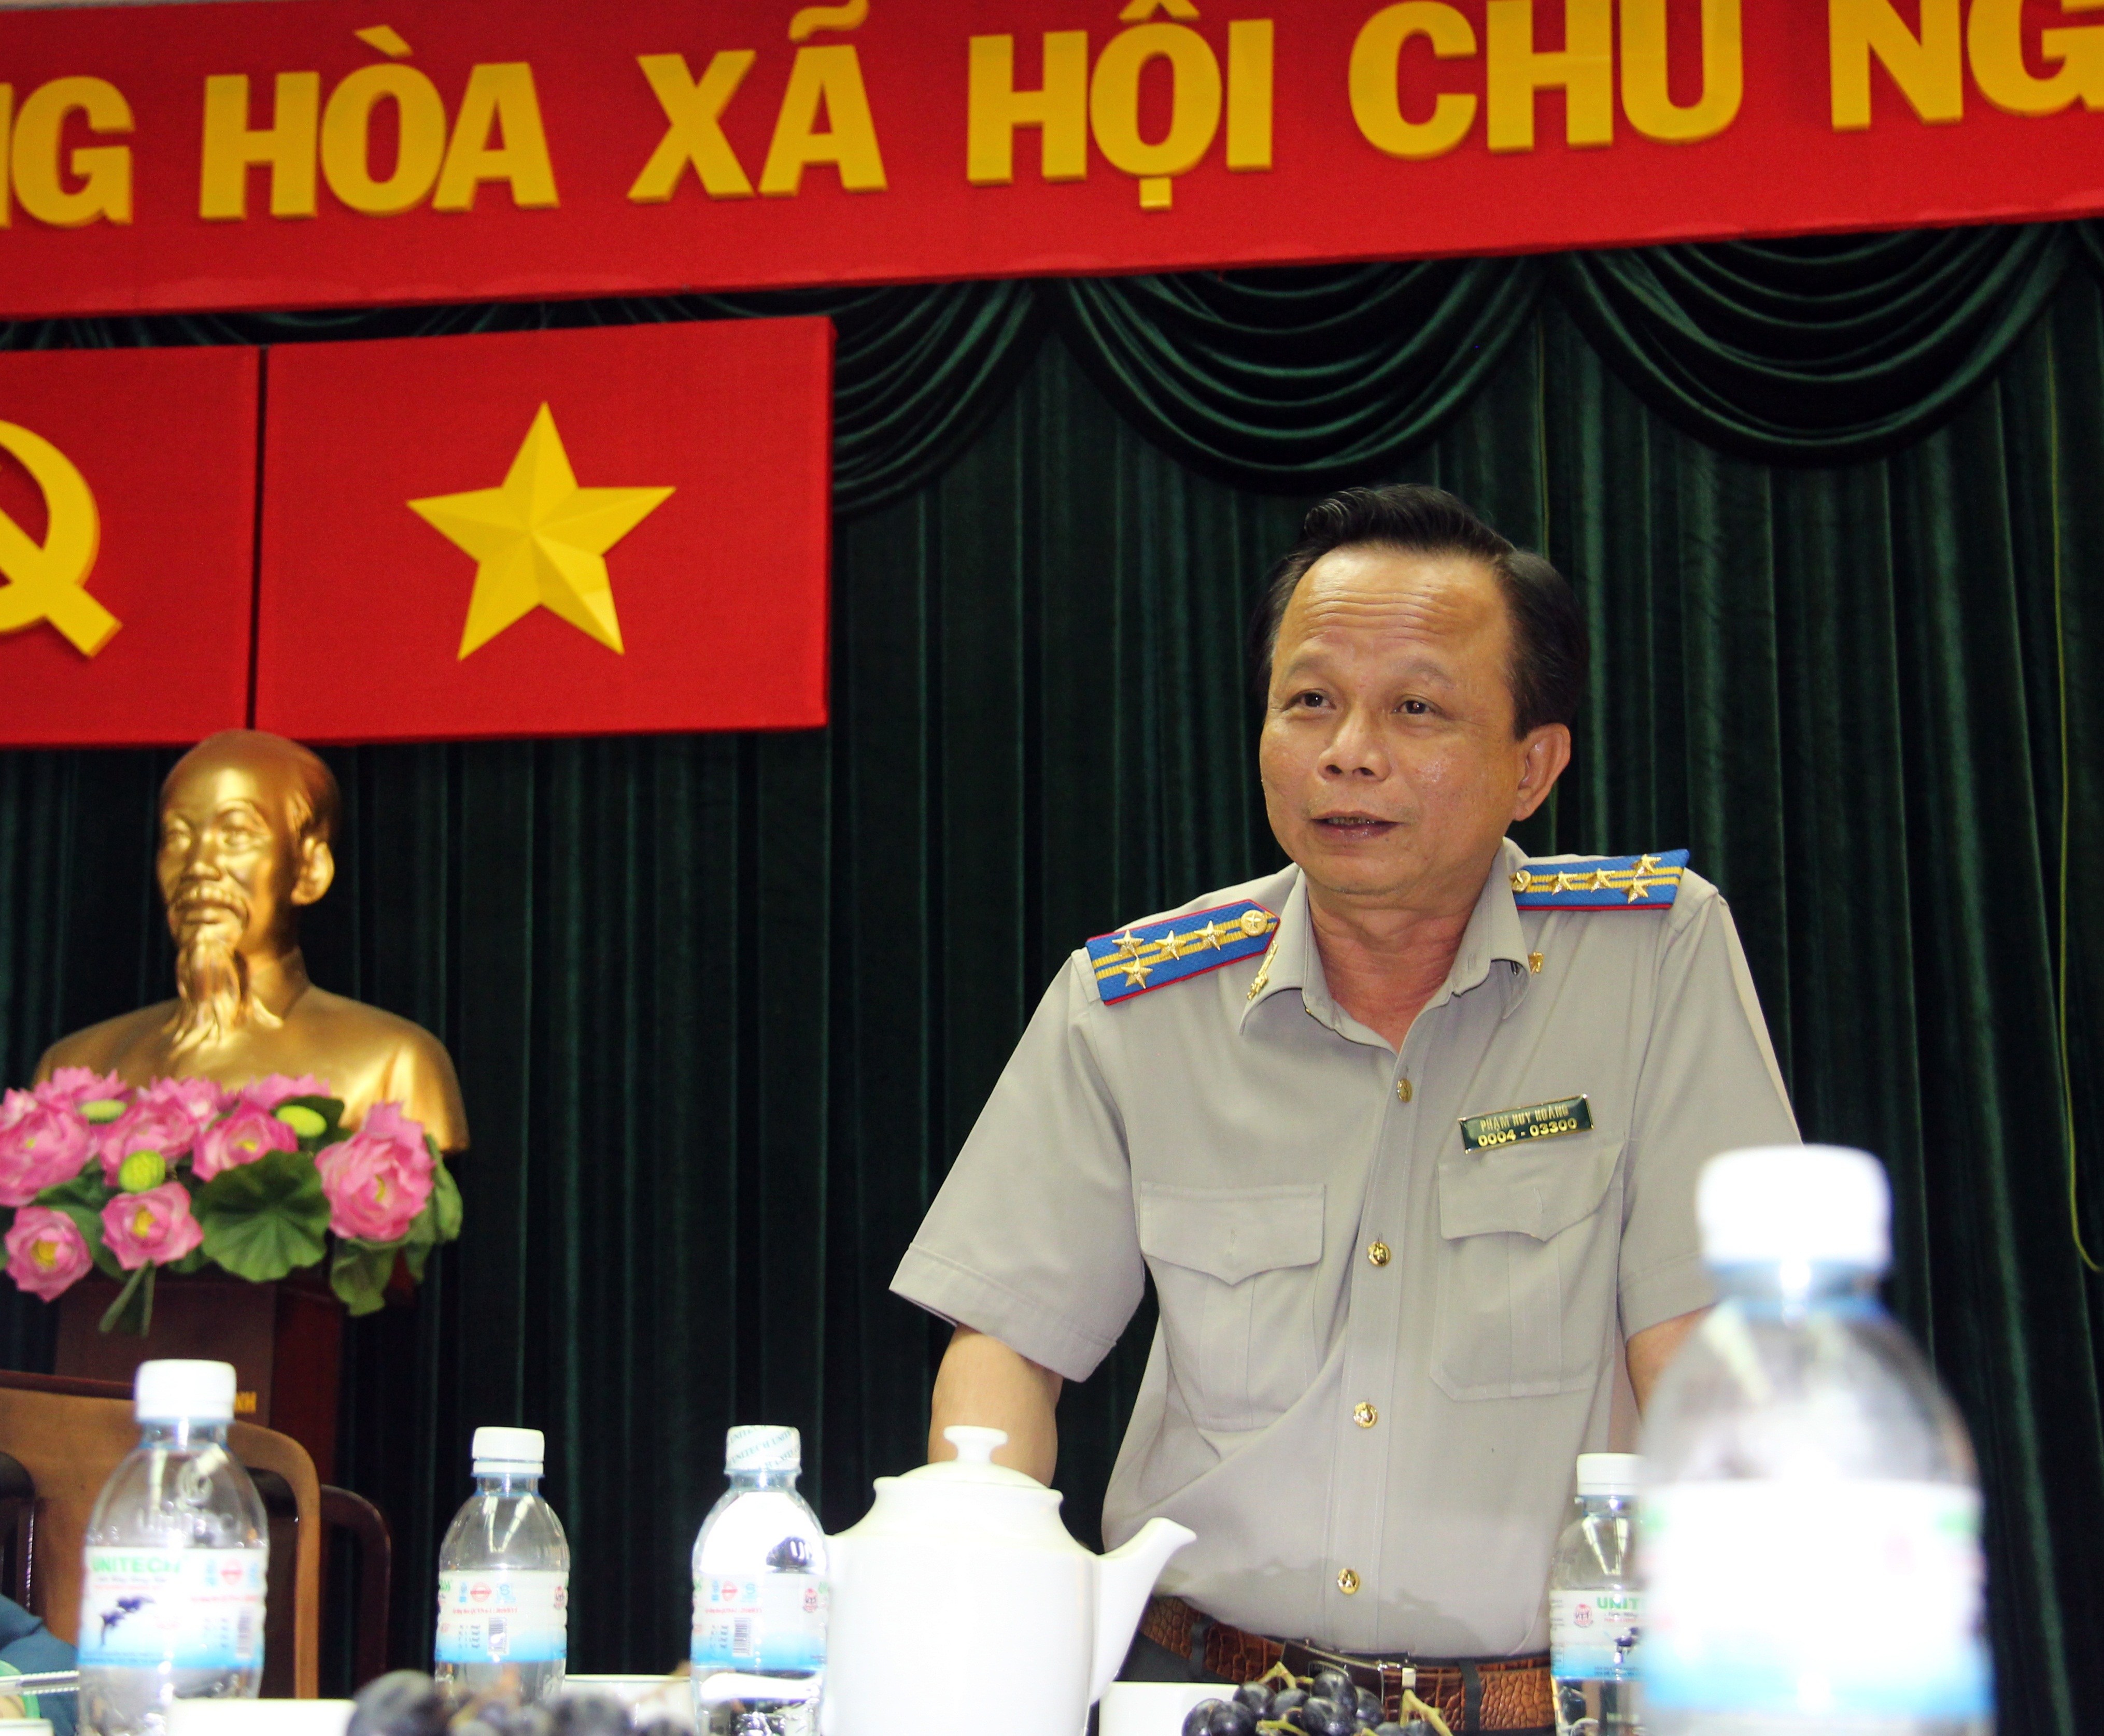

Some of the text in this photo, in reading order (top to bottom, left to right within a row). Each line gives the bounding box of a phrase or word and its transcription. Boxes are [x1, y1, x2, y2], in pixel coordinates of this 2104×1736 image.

[0, 76, 135, 228] G
[200, 24, 561, 219] HÒA
[627, 0, 888, 204] XÃ
[967, 0, 1274, 210] HỘI
[1478, 1129, 1517, 1147] 0004
[1529, 1117, 1578, 1137] 03300
[1512, 1111, 1532, 1127] HUY
